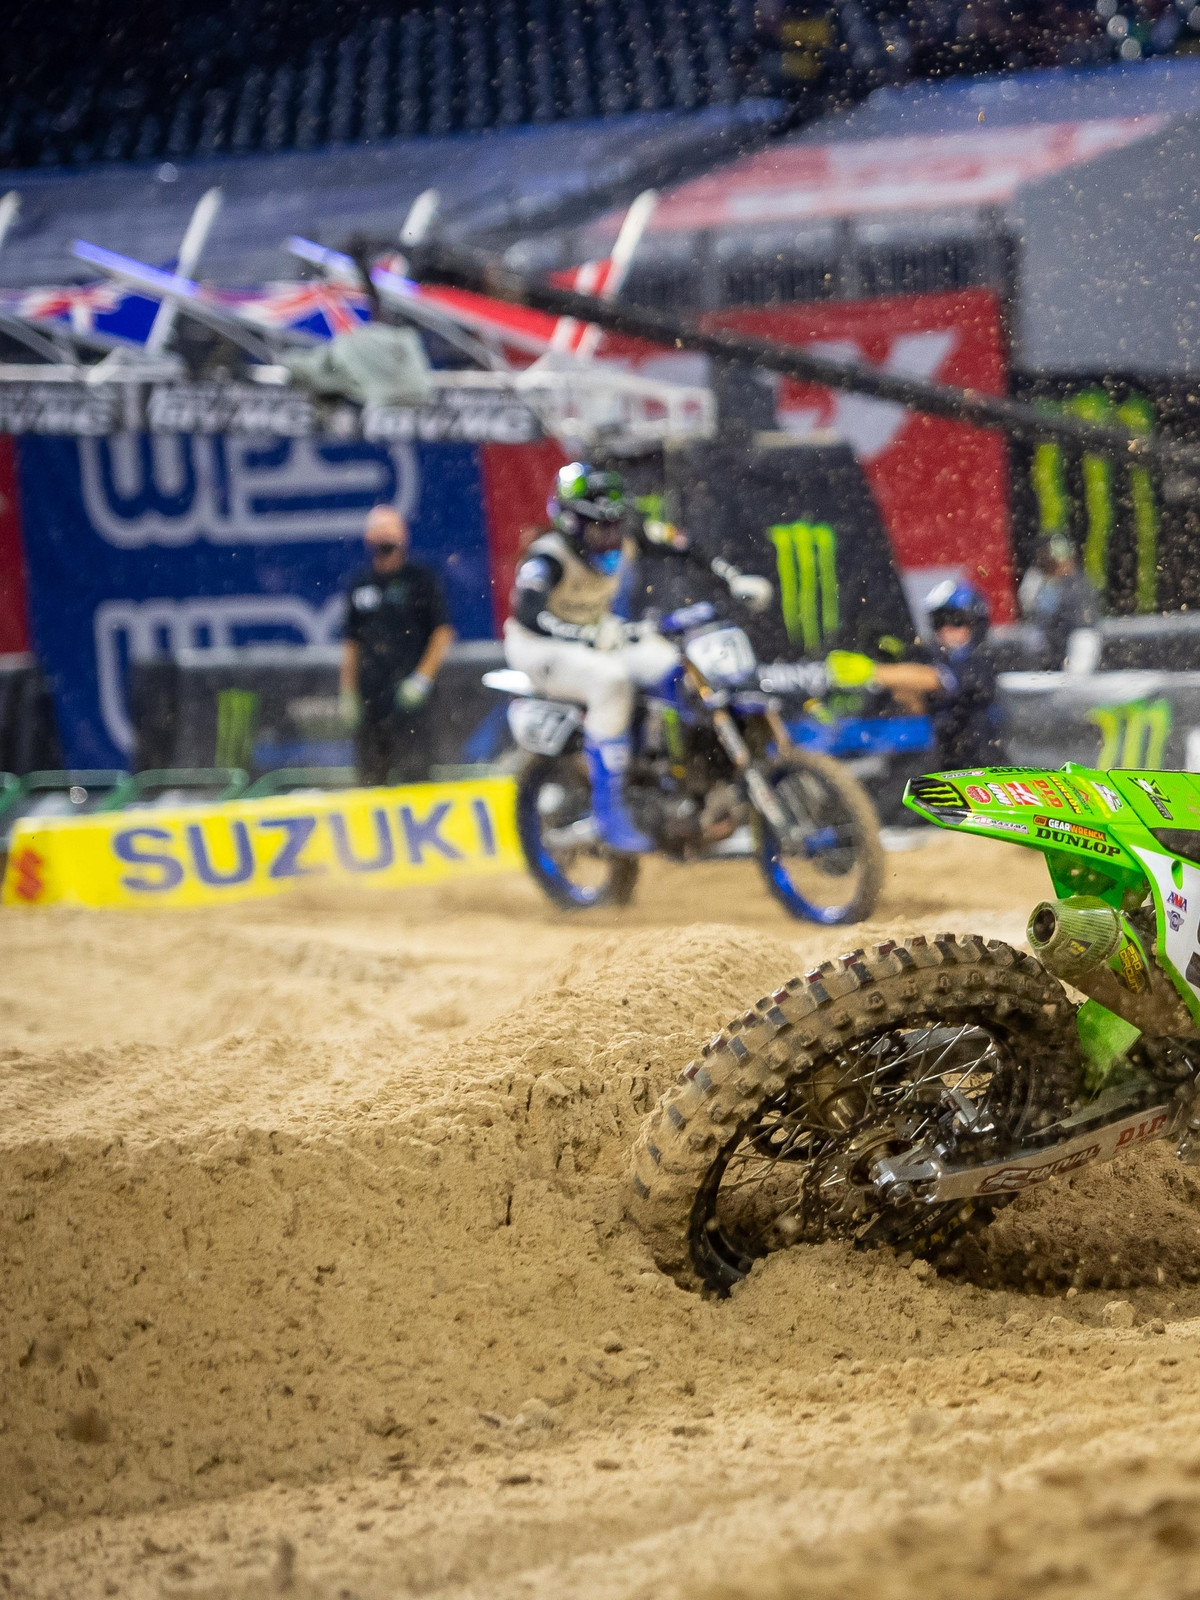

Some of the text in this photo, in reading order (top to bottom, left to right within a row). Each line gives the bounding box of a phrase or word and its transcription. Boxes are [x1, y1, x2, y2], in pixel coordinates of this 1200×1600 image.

[1032, 779, 1064, 808] DID
[1049, 776, 1083, 815] HINSON
[1035, 826, 1121, 857] DUNLOP
[1048, 818, 1107, 841] GEARWRENCH
[112, 799, 498, 892] SUZUKI
[1166, 890, 1188, 913] AMA
[1119, 949, 1138, 990] CIRCUIT
[1127, 944, 1142, 970] PRO
